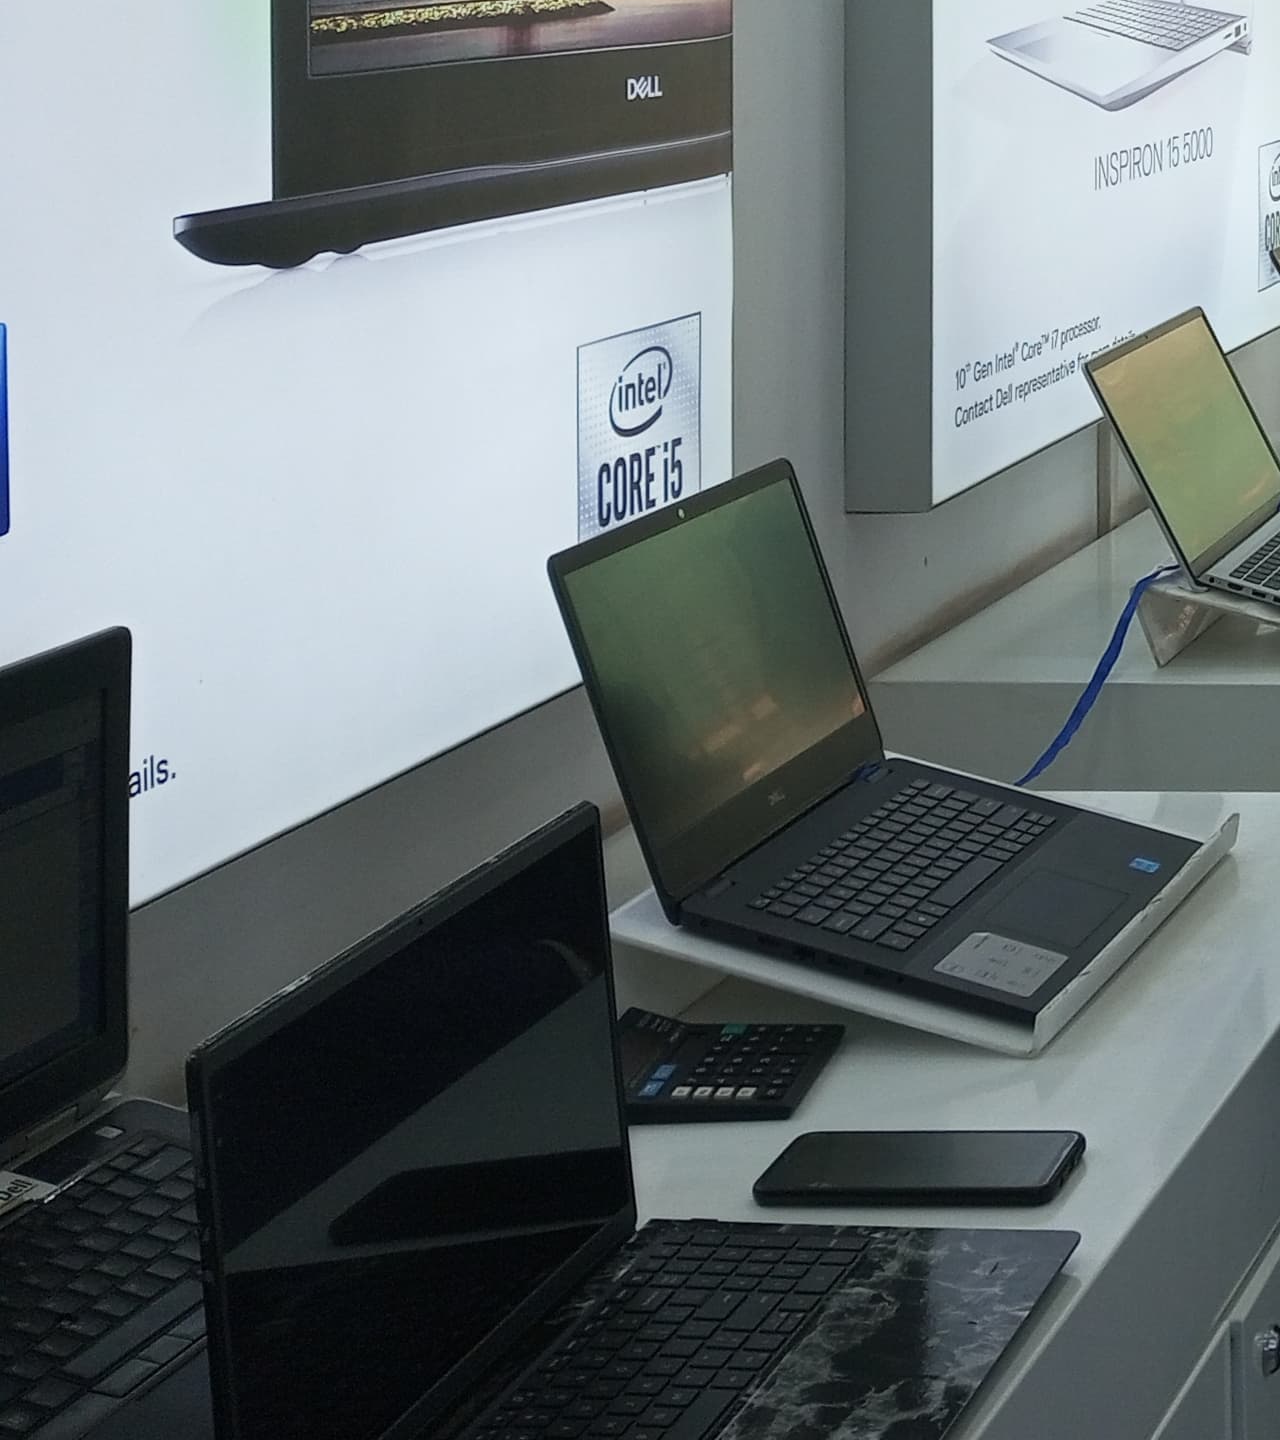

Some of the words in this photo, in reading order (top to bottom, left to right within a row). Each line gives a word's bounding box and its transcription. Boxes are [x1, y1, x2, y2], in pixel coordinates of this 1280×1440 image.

[627, 75, 663, 100] DELL
[1095, 140, 1163, 191] INSPIRON
[1167, 136, 1180, 169] 15
[1183, 127, 1214, 163] 5000
[974, 361, 993, 382] Gen
[1051, 329, 1059, 350] i7
[1060, 316, 1102, 351] processor.
[617, 361, 663, 413] intel
[955, 394, 993, 428] Contact
[996, 383, 1012, 409] Dell
[1015, 359, 1075, 402] representative
[598, 446, 656, 528] CORE
[663, 436, 682, 503] i5
